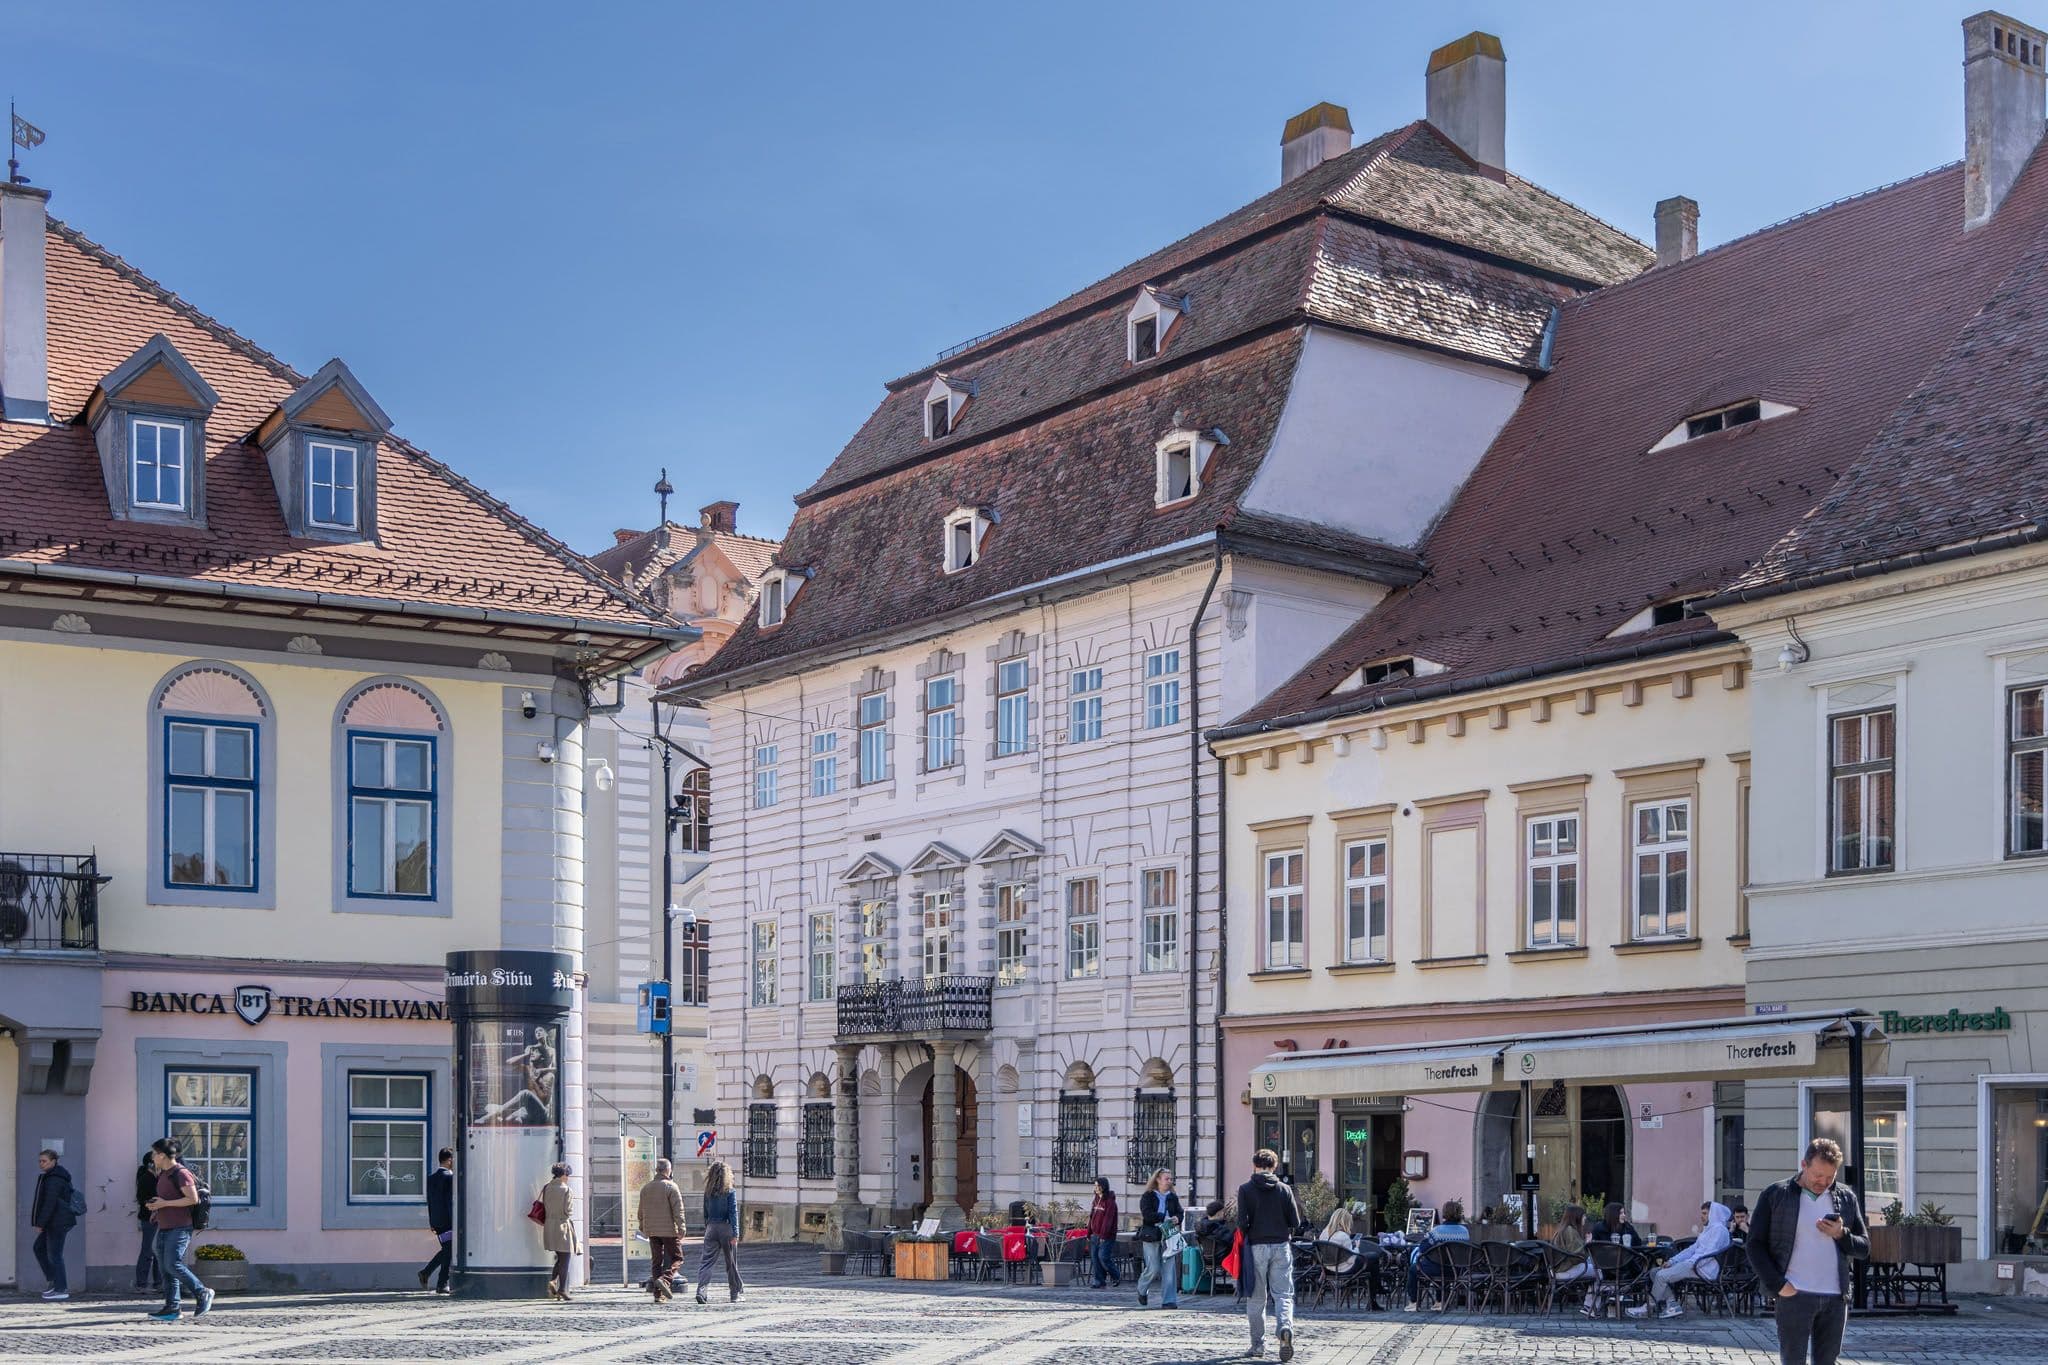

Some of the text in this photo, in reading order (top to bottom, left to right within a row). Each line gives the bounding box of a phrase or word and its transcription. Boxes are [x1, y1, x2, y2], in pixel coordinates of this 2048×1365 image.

[489, 967, 534, 987] Sibiu
[130, 991, 226, 1014] BANCA
[241, 994, 264, 1008] BT
[1879, 1006, 2011, 1034] Therefresh
[1726, 1041, 1796, 1060] Therefresh
[1424, 1063, 1478, 1081] Therefresh
